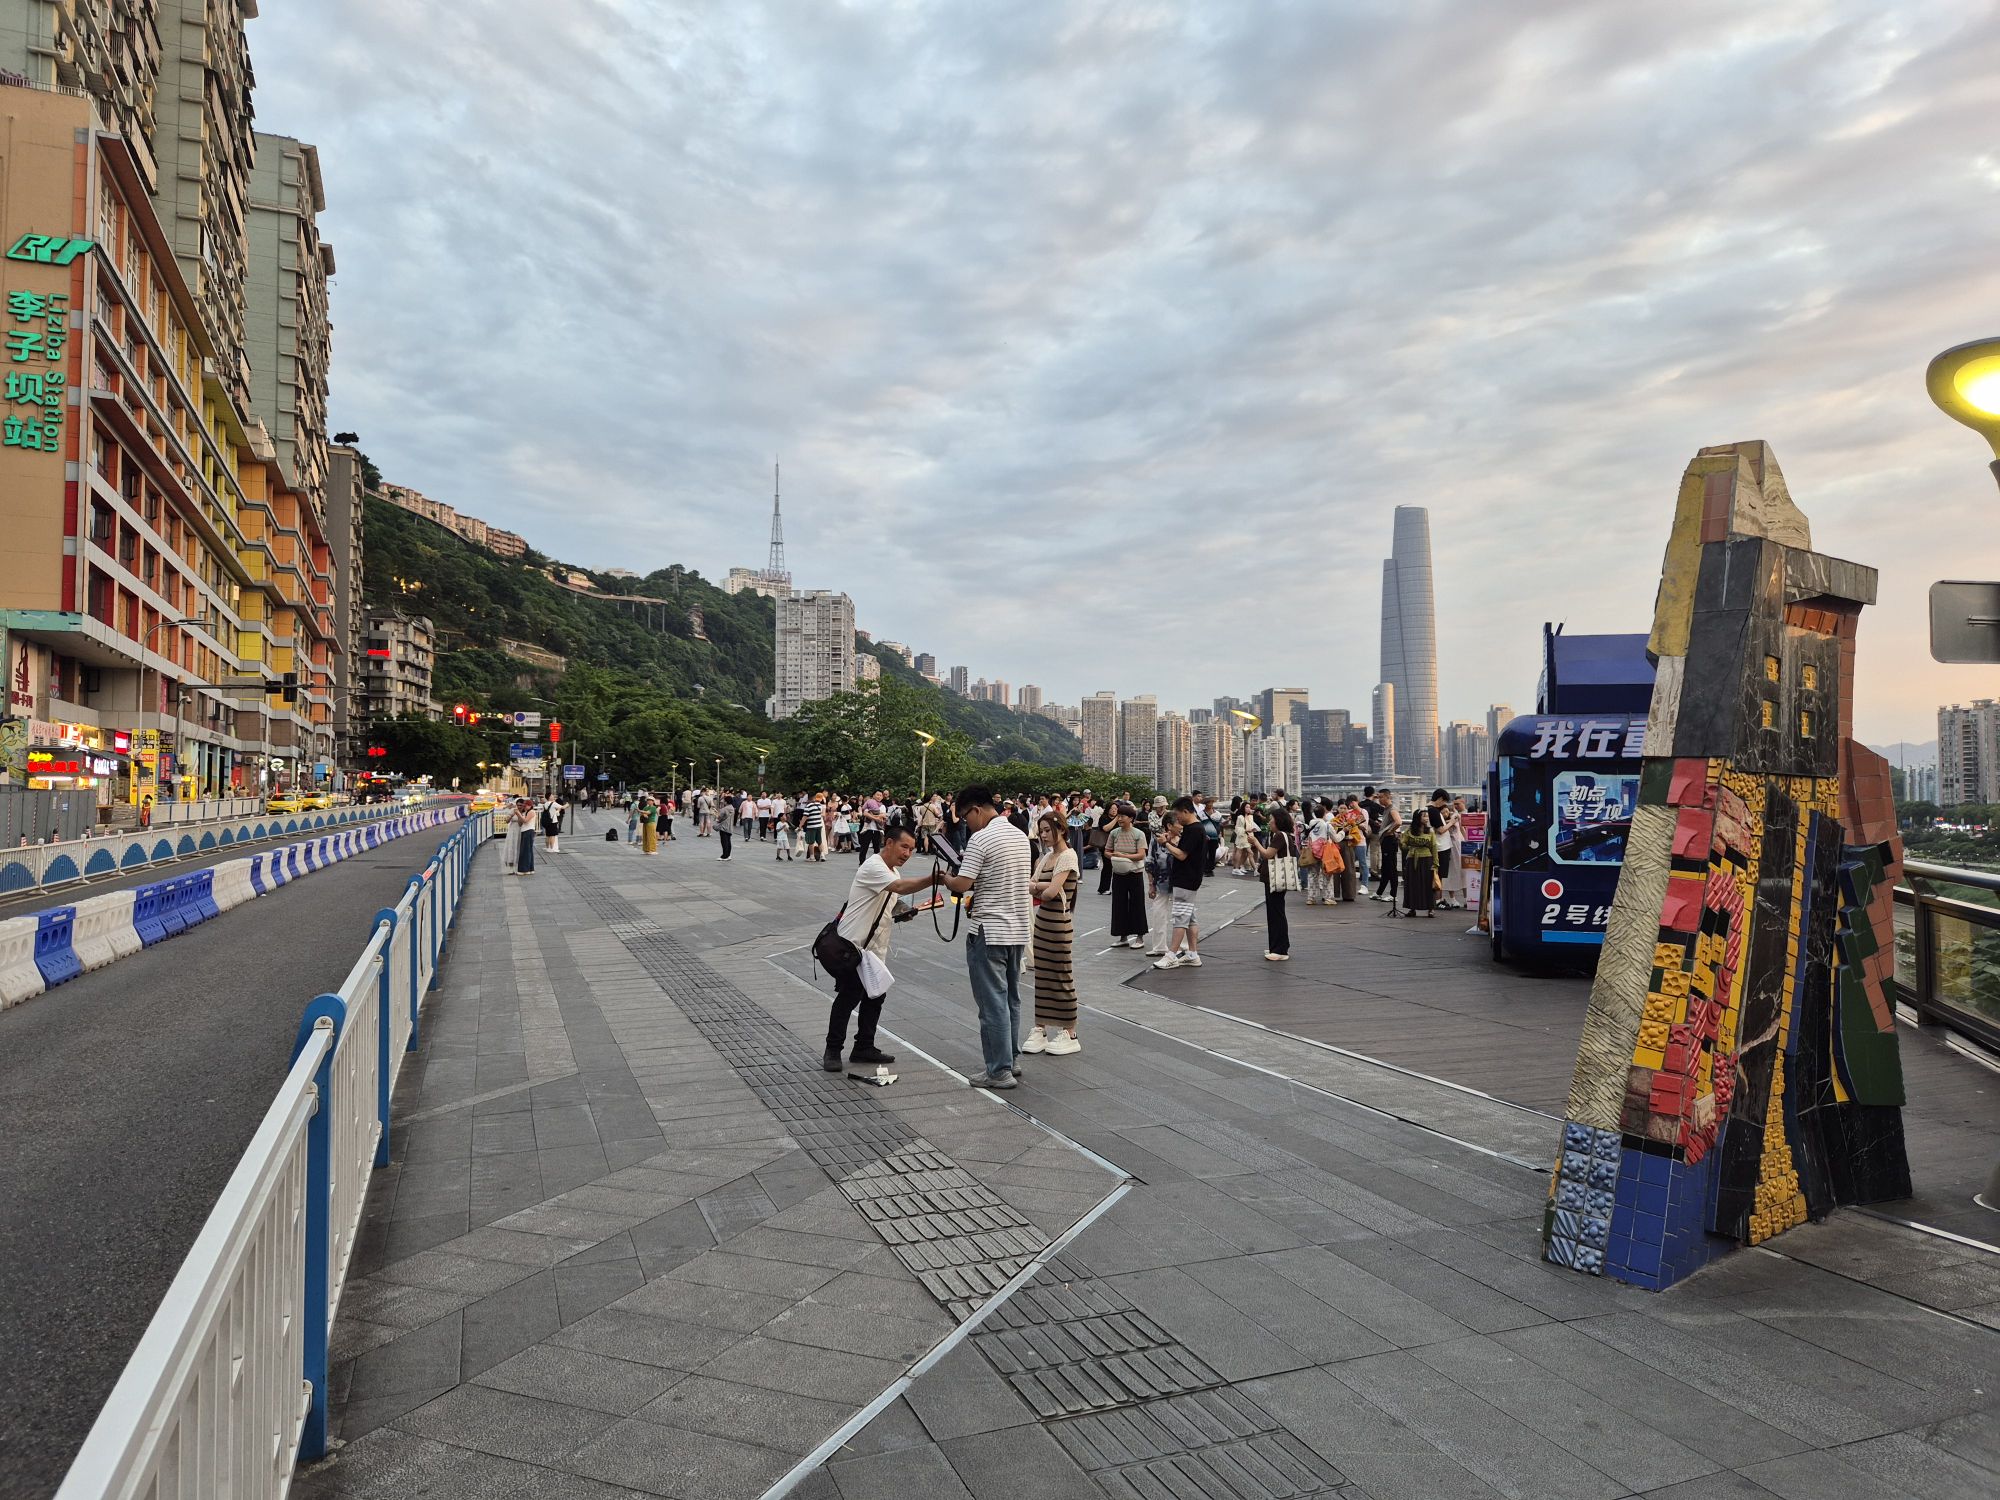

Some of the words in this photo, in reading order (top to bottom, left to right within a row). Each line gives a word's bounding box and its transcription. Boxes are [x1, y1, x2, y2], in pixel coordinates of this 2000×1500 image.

[46, 293, 69, 361] Liziba
[3, 289, 46, 450] 李子坝站
[43, 370, 65, 452] Station
[1565, 803, 1624, 820] 李子坝
[1569, 785, 1607, 802] 勒点
